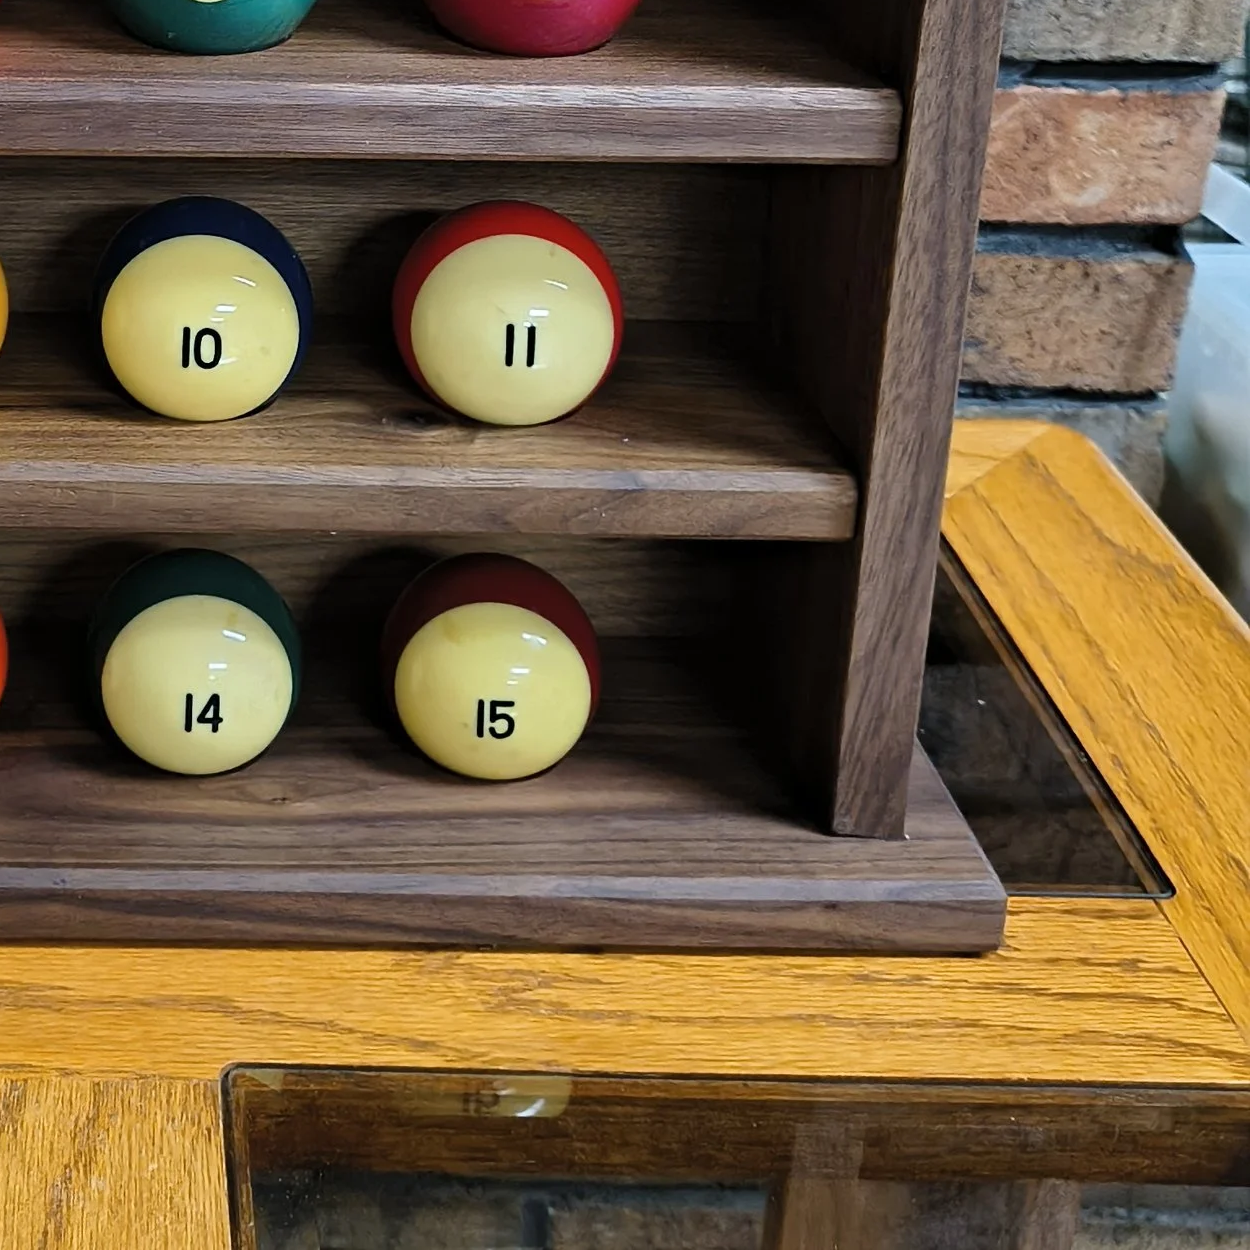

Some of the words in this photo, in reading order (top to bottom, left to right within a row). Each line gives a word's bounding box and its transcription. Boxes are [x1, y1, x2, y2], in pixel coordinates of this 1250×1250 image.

[181, 326, 223, 370] 10
[504, 323, 537, 368] 11
[184, 692, 224, 734] 14
[476, 698, 516, 740] 15
